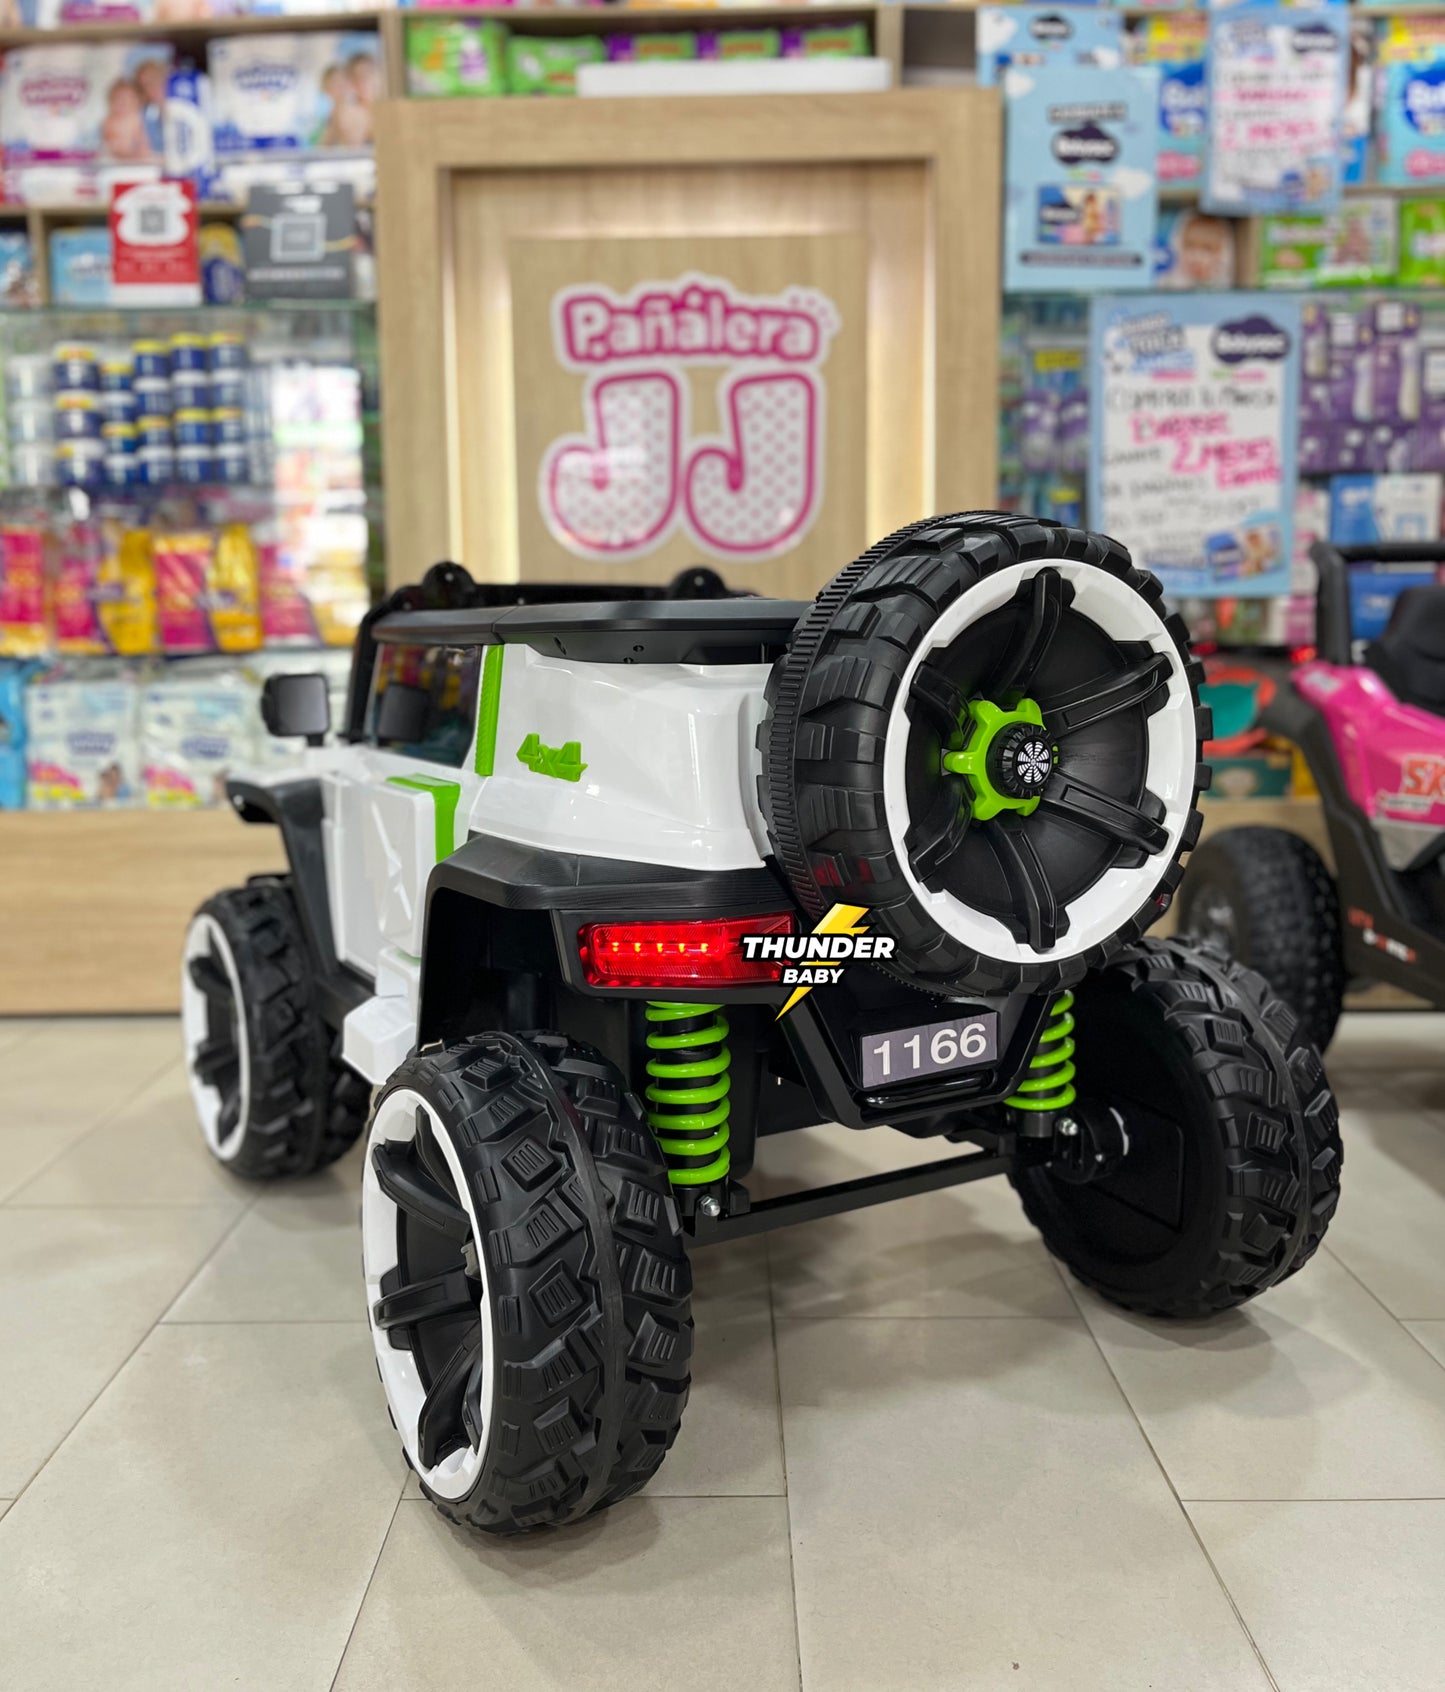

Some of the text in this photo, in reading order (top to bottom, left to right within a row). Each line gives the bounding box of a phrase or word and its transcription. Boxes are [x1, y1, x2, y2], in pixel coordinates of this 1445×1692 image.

[562, 283, 820, 363] Pañalera
[549, 372, 816, 552] JJ
[873, 1022, 987, 1076] 1166
